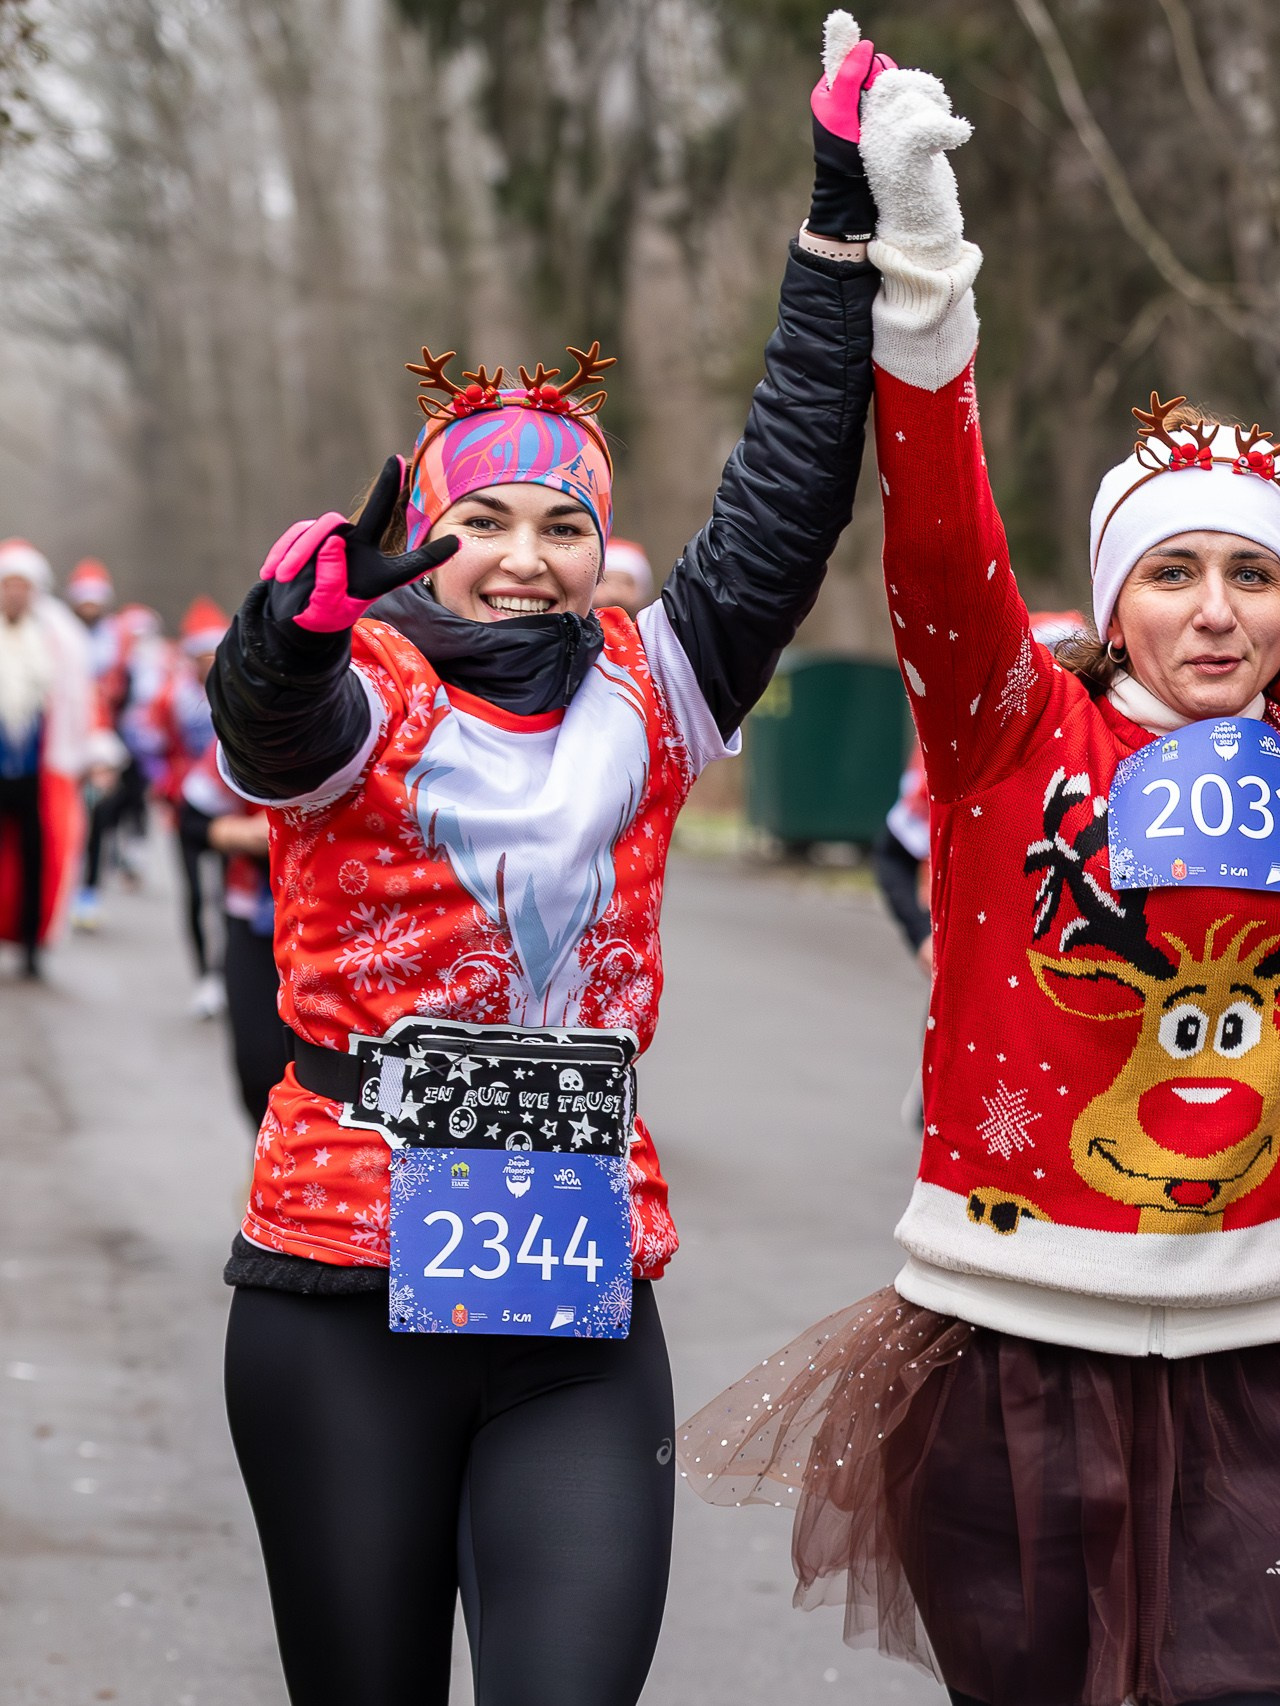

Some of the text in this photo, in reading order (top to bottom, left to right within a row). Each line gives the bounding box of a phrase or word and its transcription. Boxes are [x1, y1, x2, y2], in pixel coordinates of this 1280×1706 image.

[1219, 863, 1228, 876] 5
[1230, 866, 1248, 877] км
[423, 1085, 621, 1113] IN RUN WE TRUST
[422, 1210, 604, 1282] 2344
[501, 1309, 511, 1322] 5
[513, 1313, 532, 1323] км
